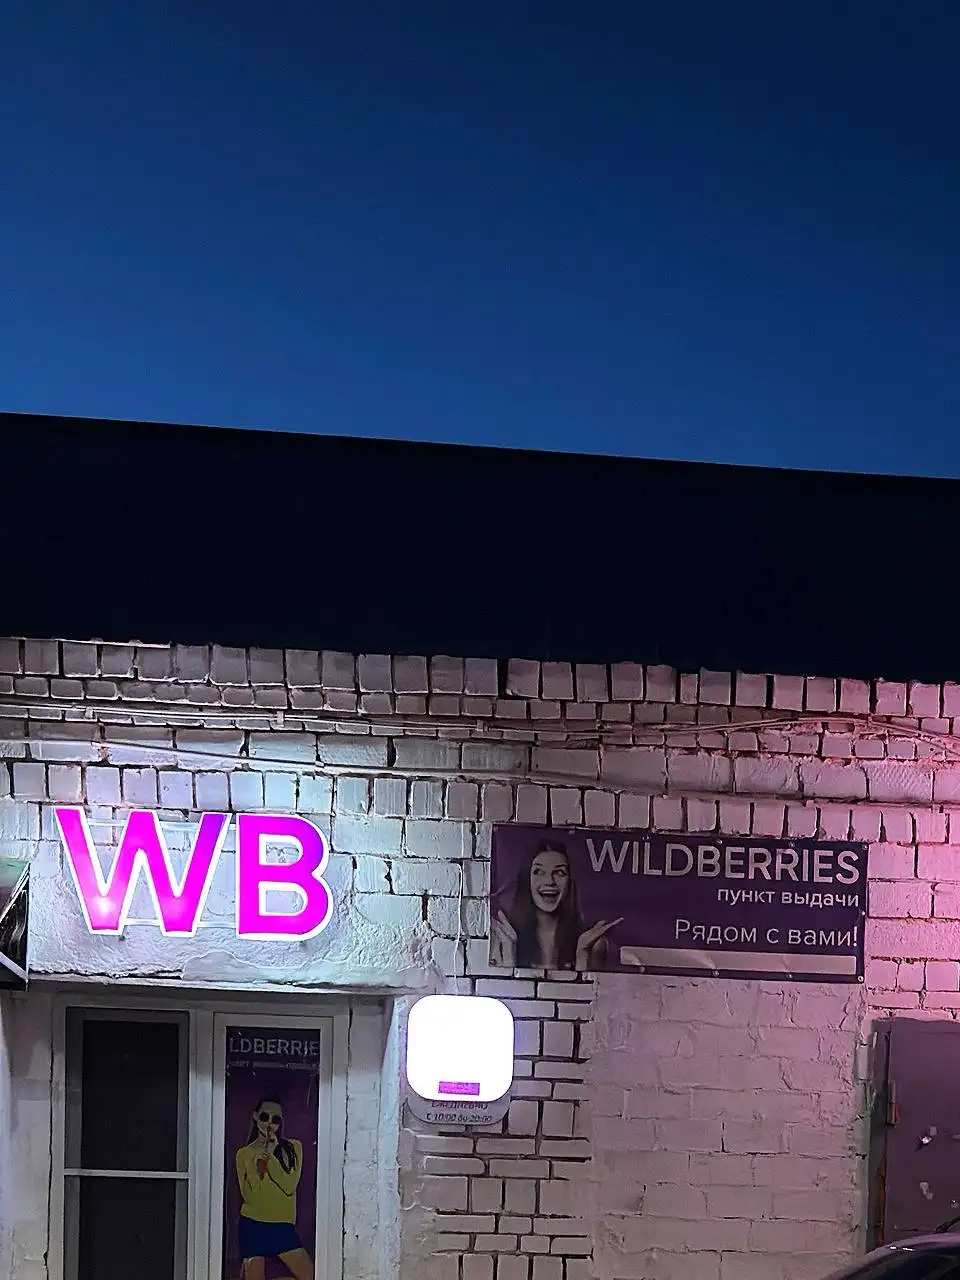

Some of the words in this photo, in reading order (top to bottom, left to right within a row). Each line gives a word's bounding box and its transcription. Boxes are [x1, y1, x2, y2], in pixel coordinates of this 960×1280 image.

[54, 806, 334, 941] WB
[586, 838, 859, 884] WILDBERRIES
[717, 888, 775, 906] пункт
[782, 891, 859, 908] выдачи
[675, 919, 757, 944] Рядом
[766, 927, 779, 944] с
[788, 926, 858, 947] вами!
